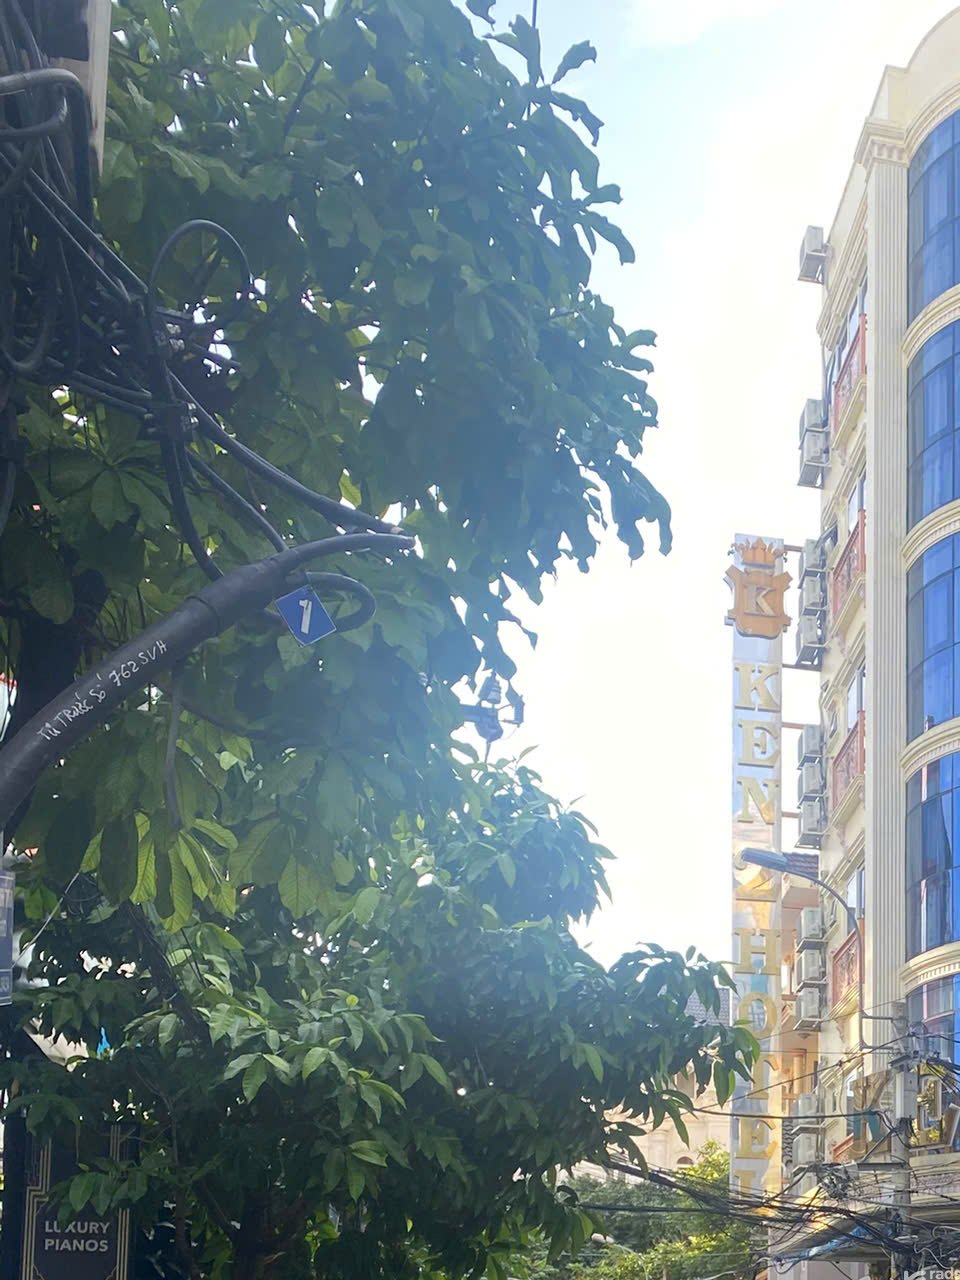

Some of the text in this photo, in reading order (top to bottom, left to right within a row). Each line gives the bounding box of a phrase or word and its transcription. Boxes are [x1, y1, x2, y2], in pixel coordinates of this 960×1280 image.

[300, 599, 312, 634] 1
[109, 661, 140, 687] 762
[138, 640, 168, 665] SVH
[44, 1239, 109, 1252] PIANOS
